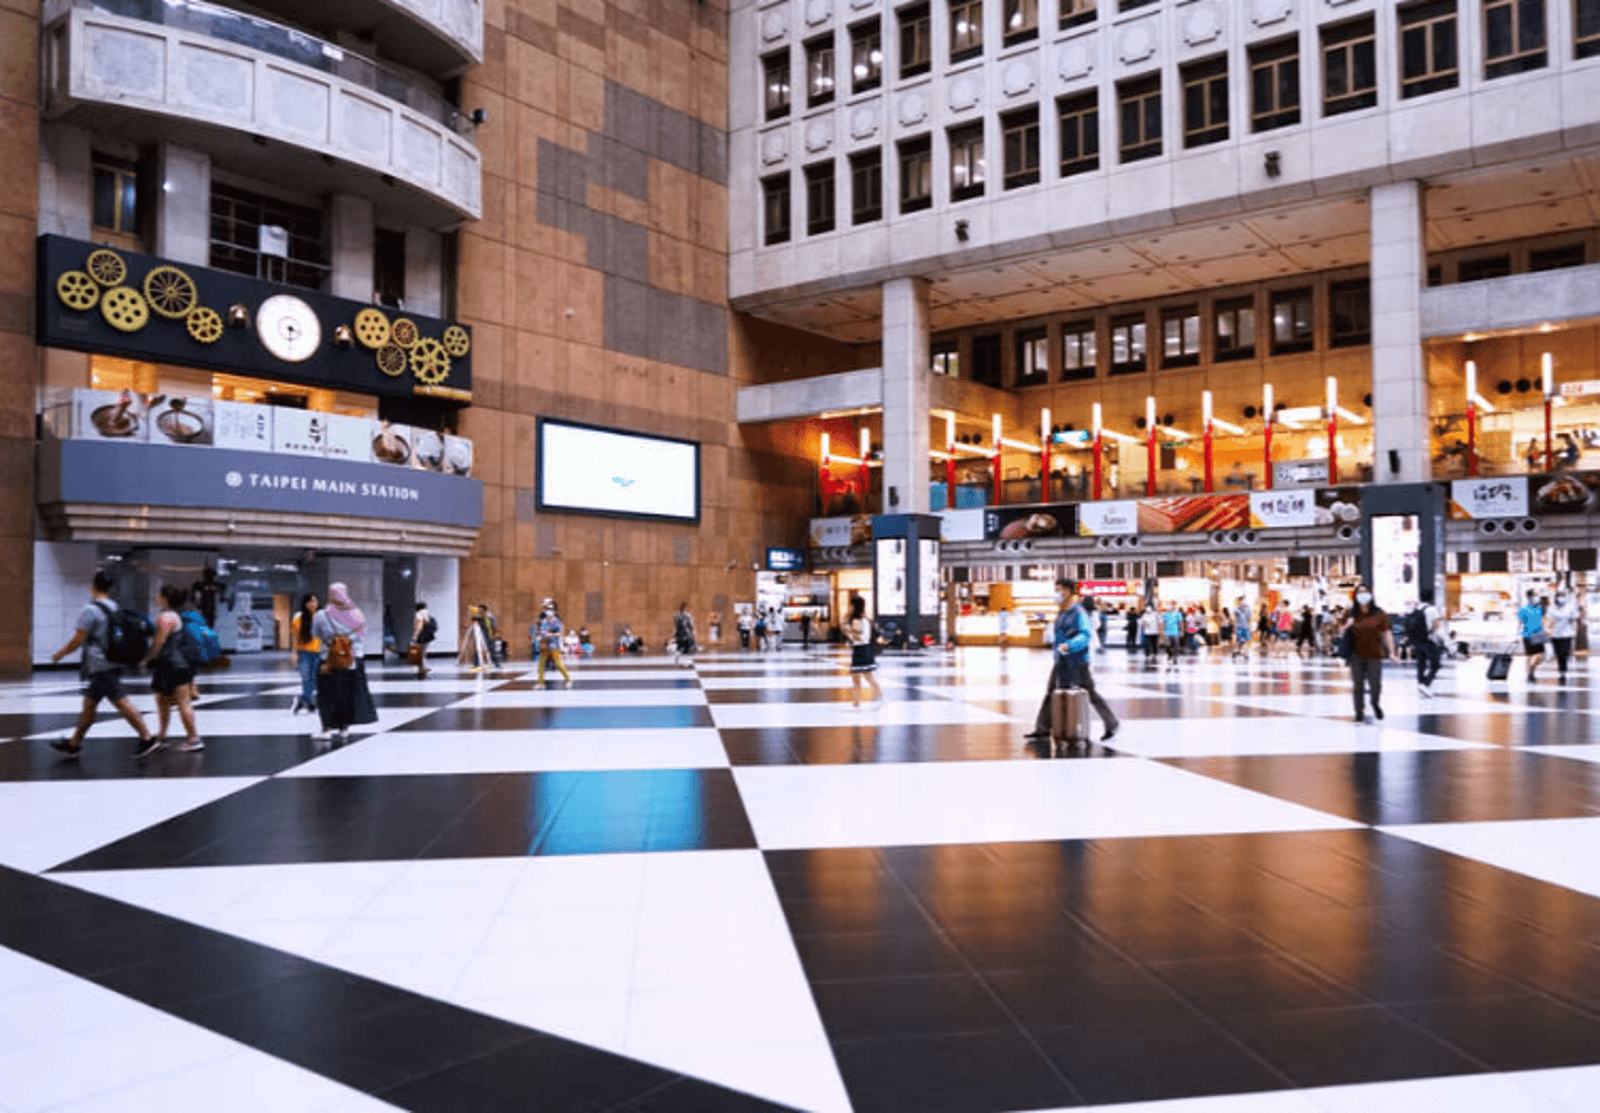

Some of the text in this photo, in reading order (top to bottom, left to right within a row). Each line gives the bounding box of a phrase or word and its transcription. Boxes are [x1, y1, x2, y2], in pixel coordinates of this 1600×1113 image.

[250, 473, 419, 500] TAIPEI MAIN STATION
